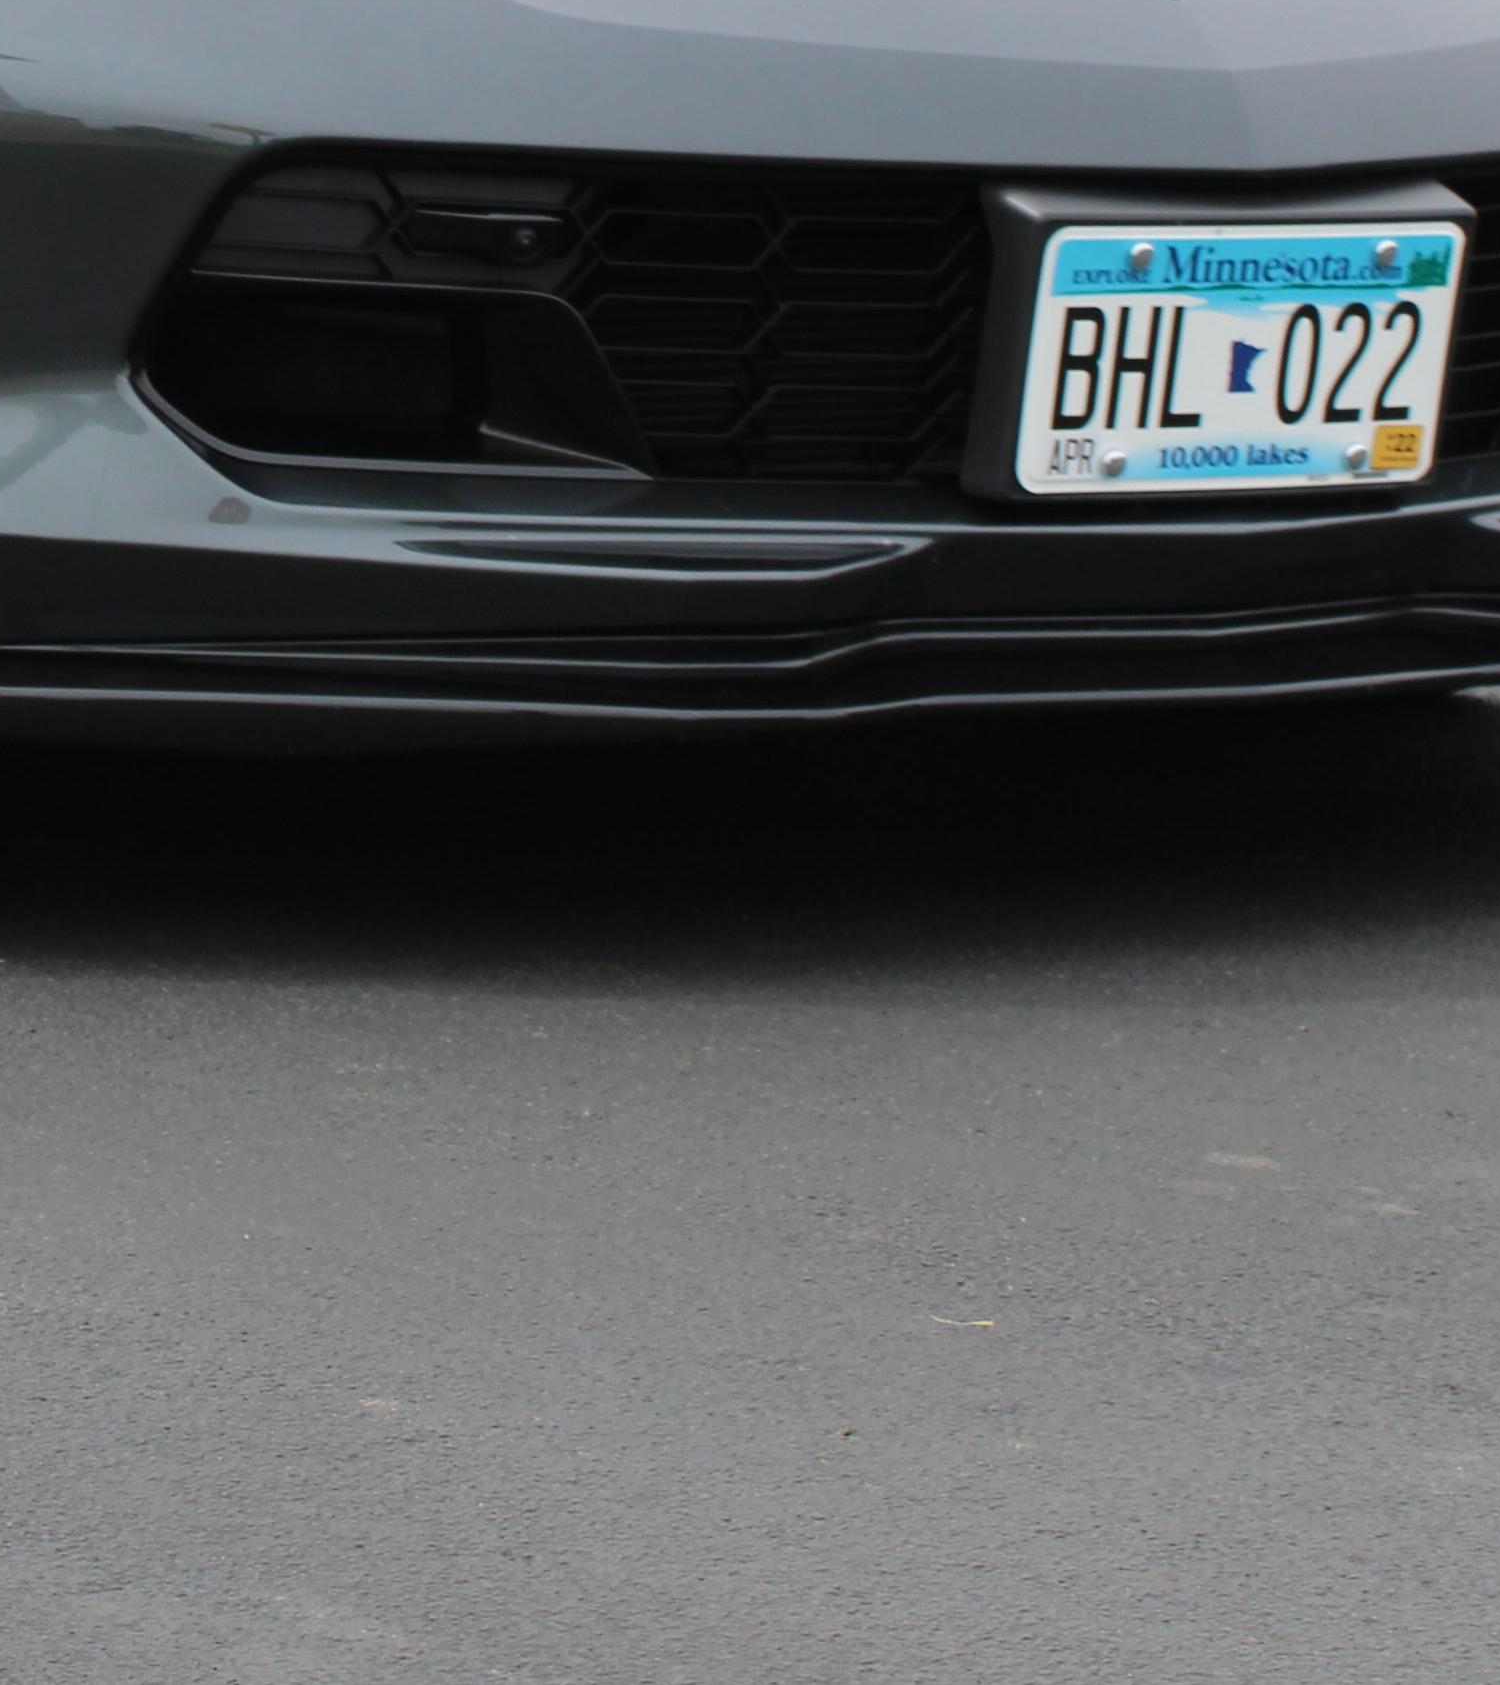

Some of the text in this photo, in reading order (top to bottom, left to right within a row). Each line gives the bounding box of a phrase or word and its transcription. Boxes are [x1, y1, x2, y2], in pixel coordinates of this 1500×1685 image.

[1050, 300, 1421, 430] BHL 022
[1048, 438, 1095, 476] APR
[1158, 443, 1311, 470] 10,000 lakes
